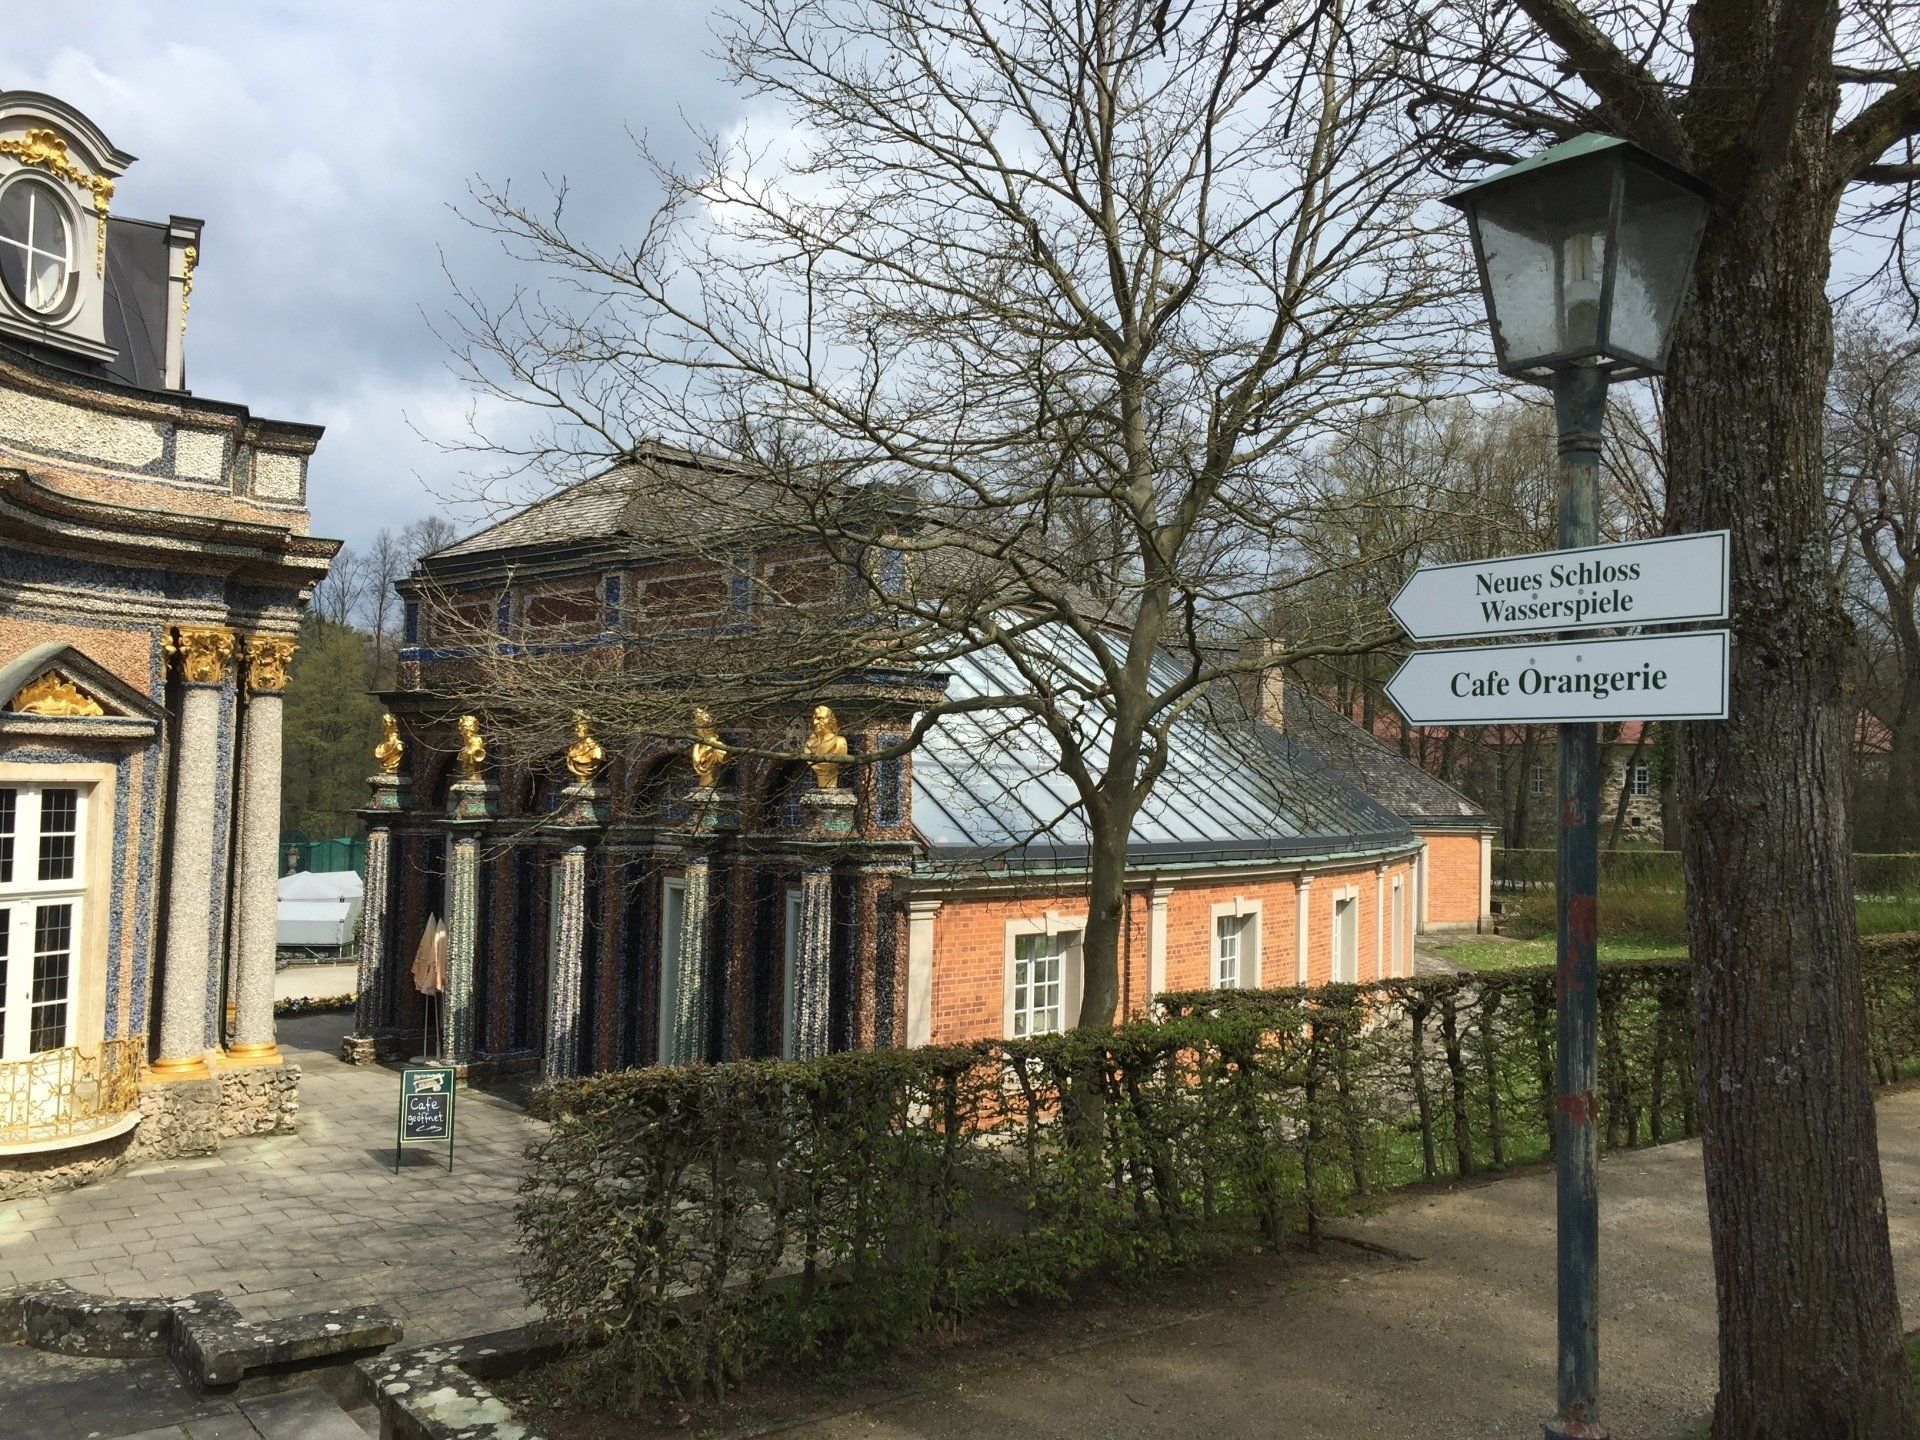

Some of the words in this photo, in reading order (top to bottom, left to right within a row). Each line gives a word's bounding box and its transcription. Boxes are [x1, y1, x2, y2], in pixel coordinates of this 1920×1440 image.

[1475, 572, 1542, 596] Neues
[1550, 560, 1641, 589] Schloss
[1482, 589, 1633, 623] Wasserspiele
[1450, 670, 1510, 697] Cafe
[1518, 662, 1667, 699] Orangerie
[407, 1111, 443, 1125] geöffnet
